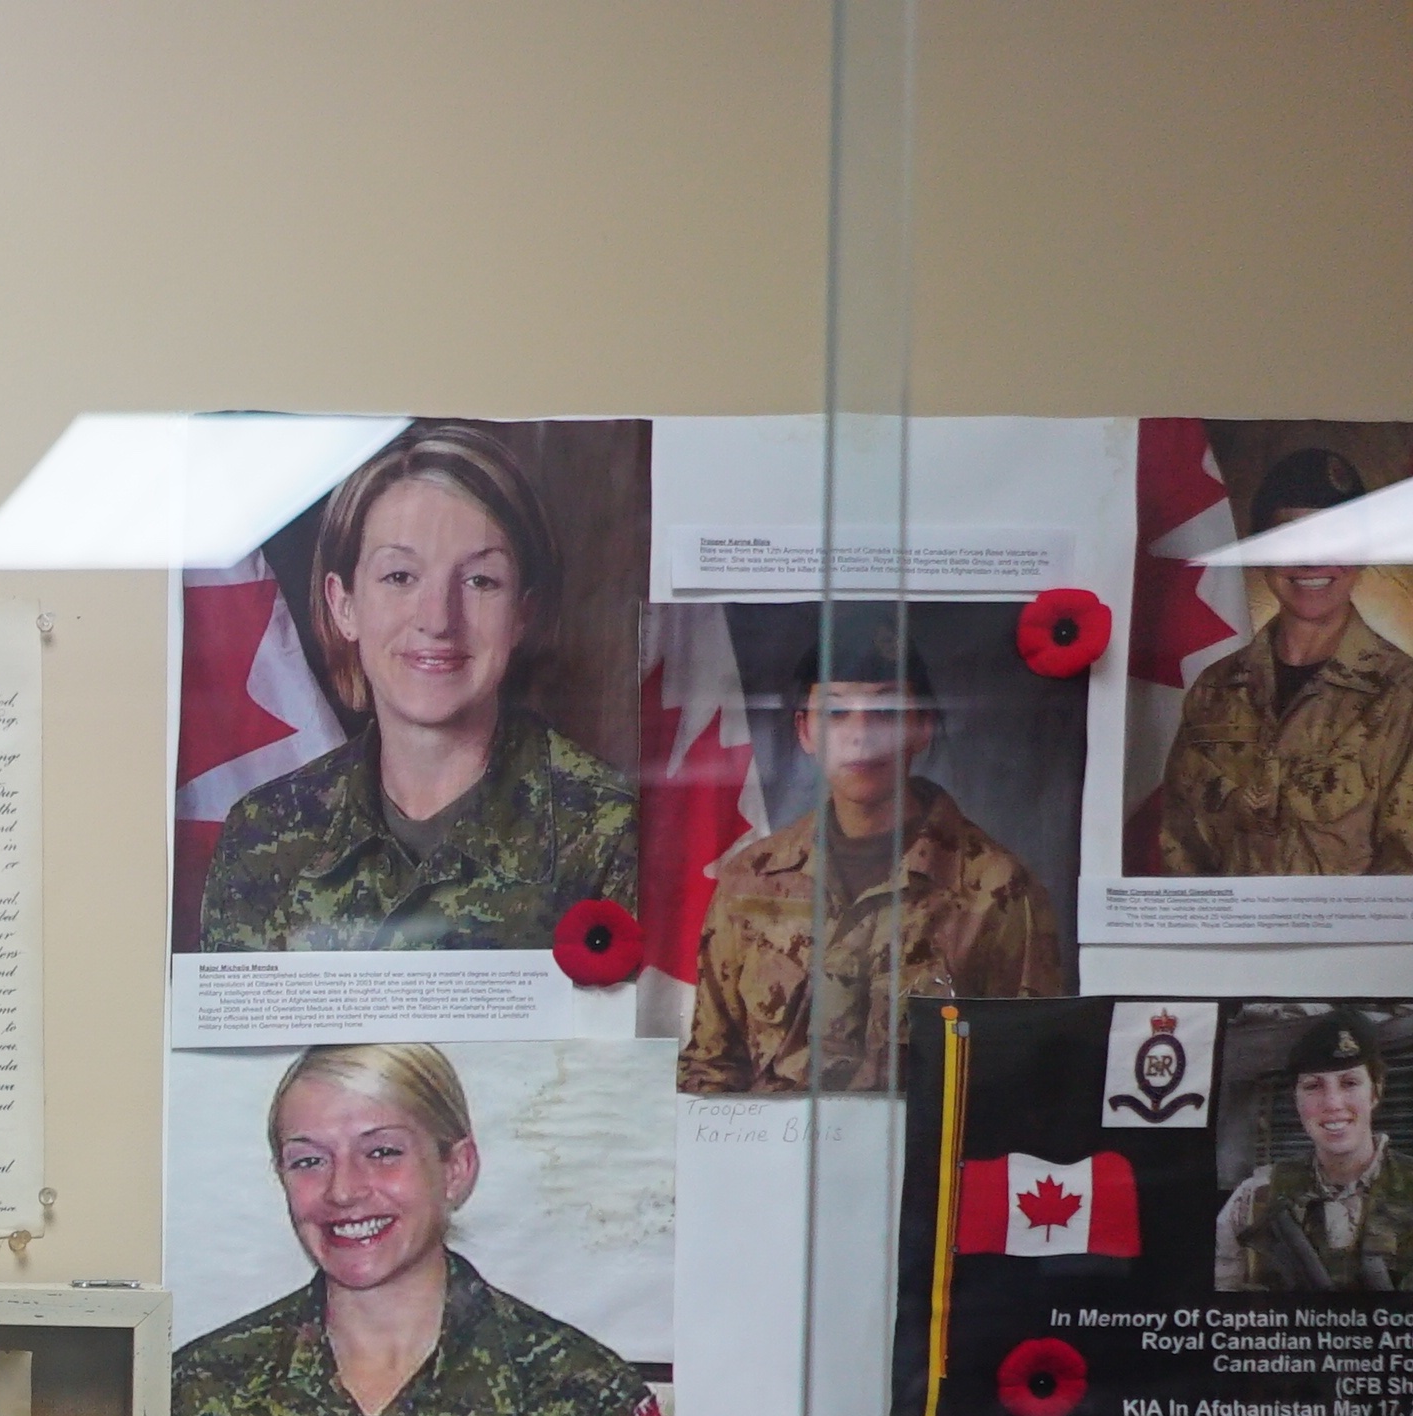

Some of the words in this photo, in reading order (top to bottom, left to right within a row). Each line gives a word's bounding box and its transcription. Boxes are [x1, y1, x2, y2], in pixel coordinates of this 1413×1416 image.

[686, 1099, 770, 1124] Trooper
[695, 1124, 770, 1143] Karine
[1050, 1308, 1071, 1327] In
[1078, 1308, 1168, 1331] Memory
[1173, 1308, 1200, 1327] Of
[1206, 1309, 1289, 1331] Captain
[1295, 1308, 1368, 1327] Nichola
[1141, 1332, 1204, 1354] Royal
[1210, 1331, 1312, 1351] Canadian
[1317, 1331, 1374, 1350] Horse
[1213, 1354, 1316, 1373] Canadian
[1321, 1354, 1384, 1372] Armed
[1335, 1376, 1383, 1400] (CFB
